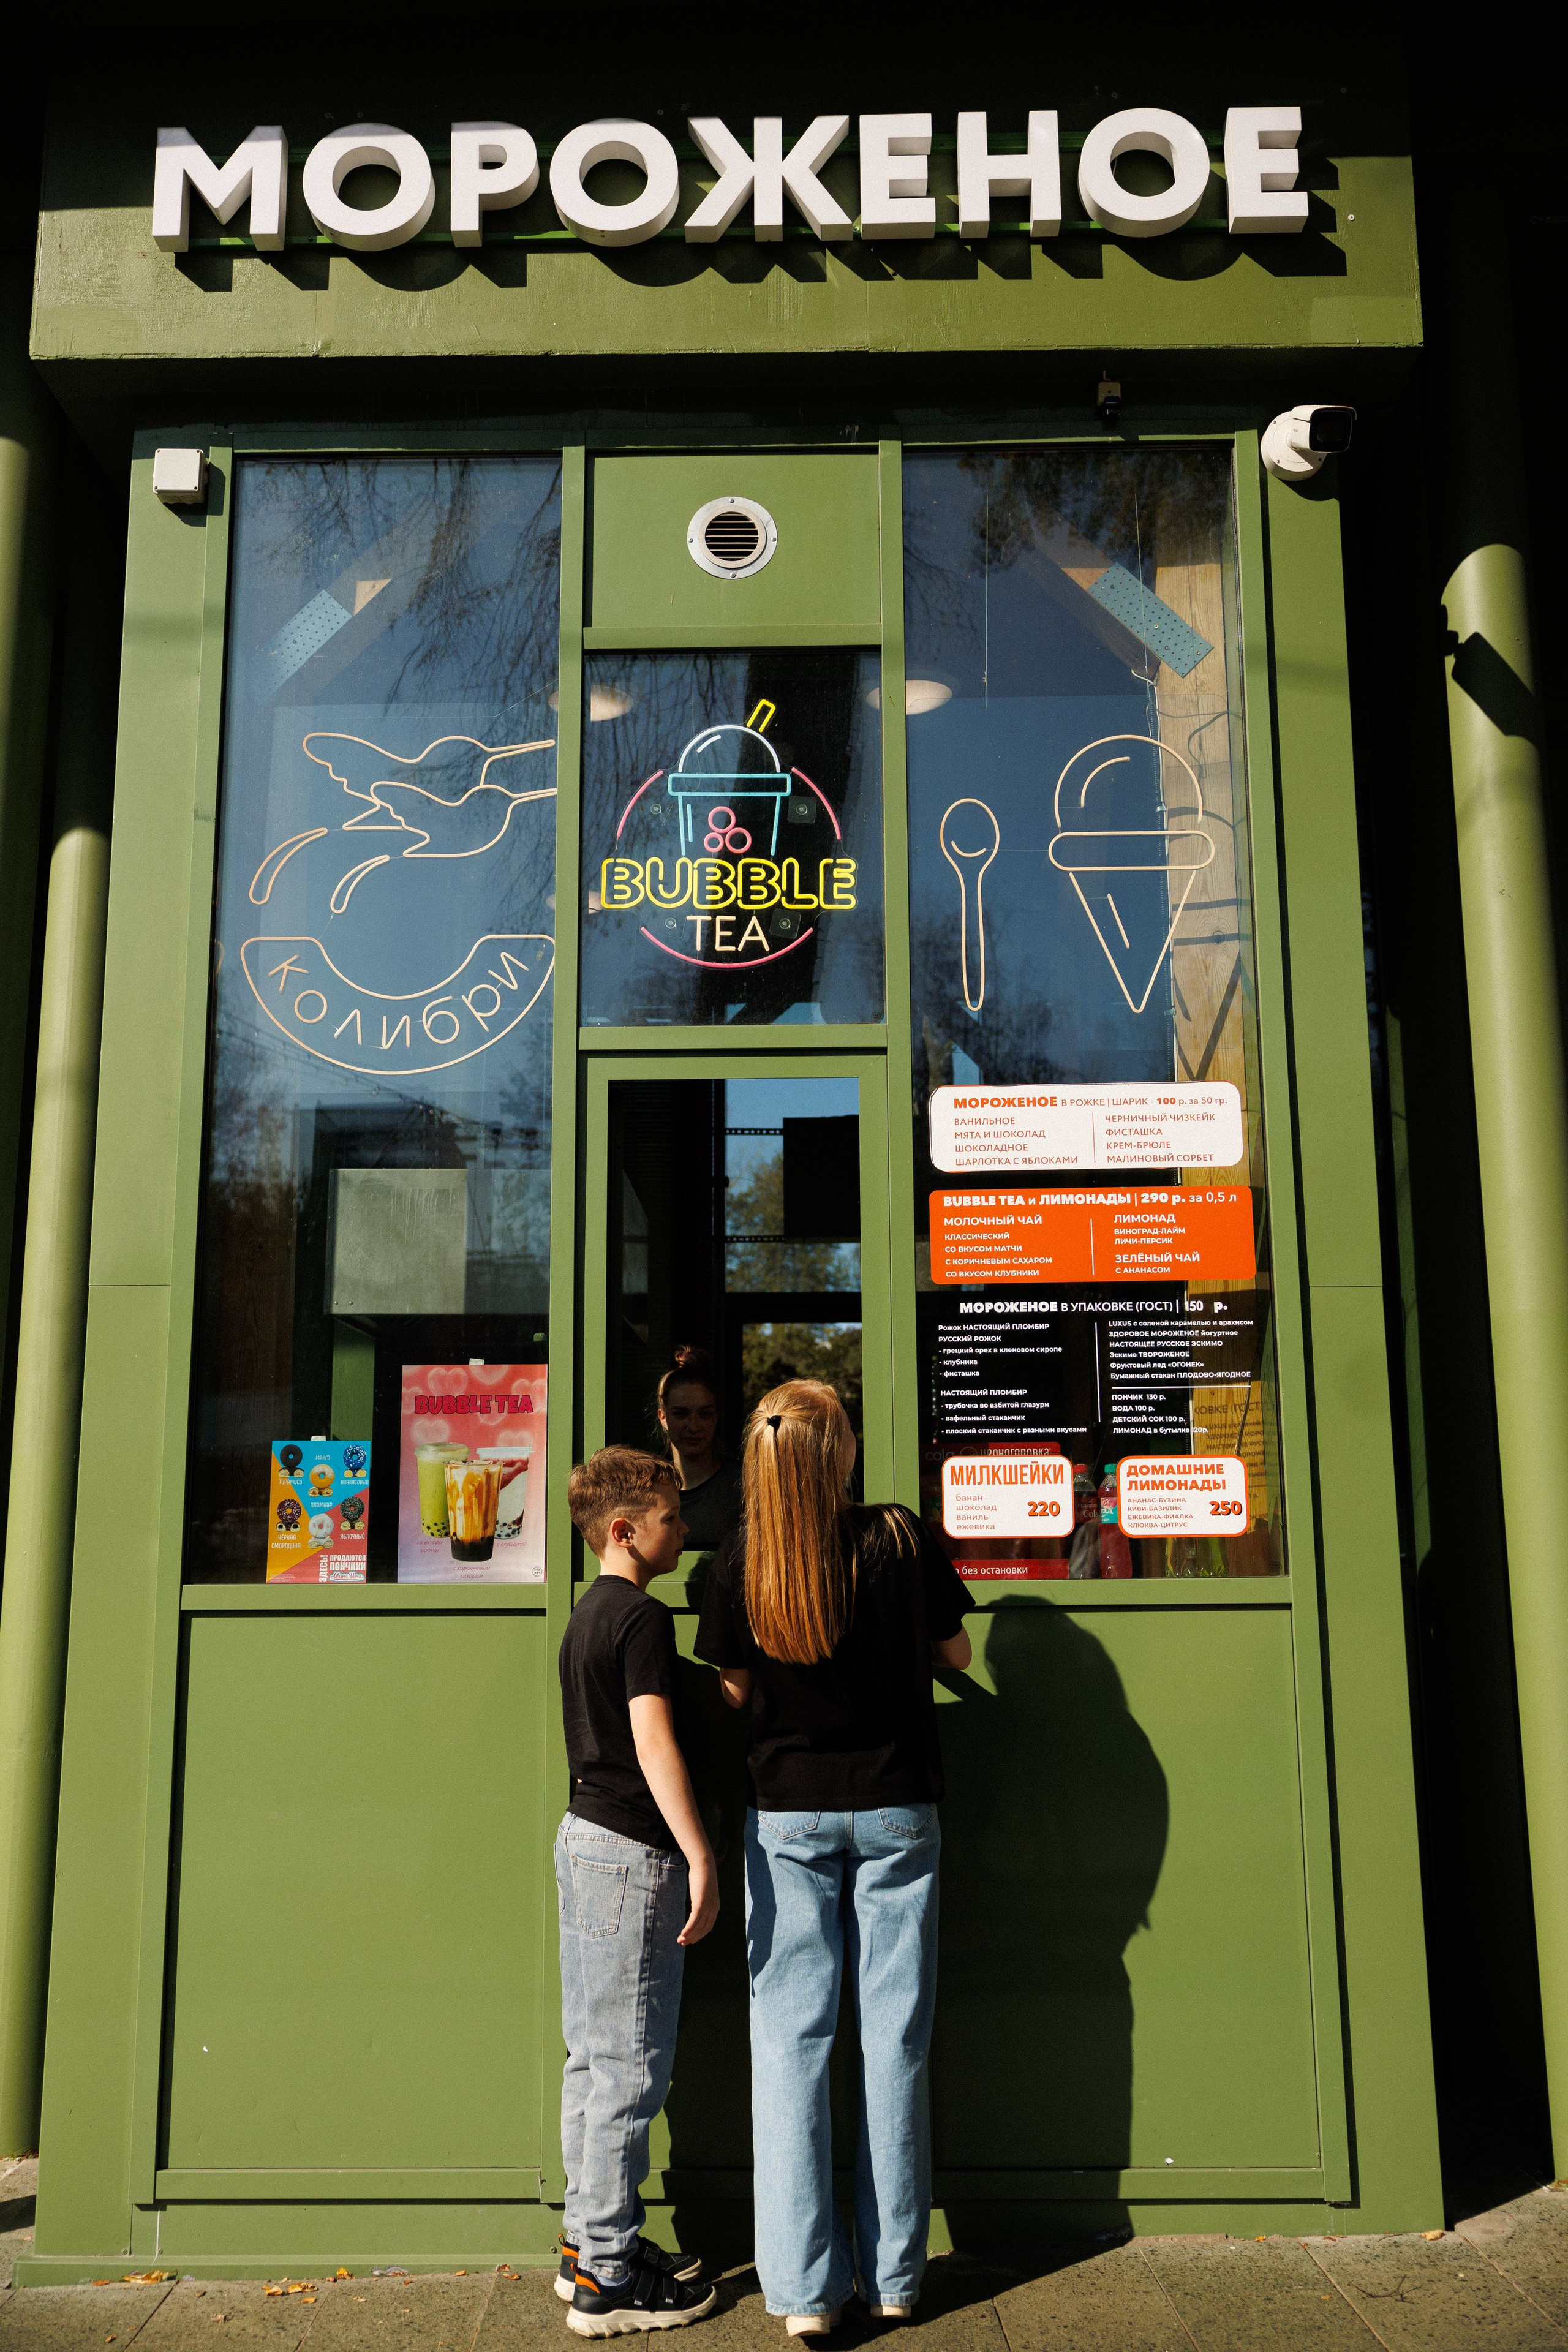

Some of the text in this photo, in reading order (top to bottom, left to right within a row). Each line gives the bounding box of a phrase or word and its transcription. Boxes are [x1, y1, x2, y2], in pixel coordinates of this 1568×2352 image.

[152, 107, 1308, 251] МОРОЖЕНОЕ
[601, 858, 856, 909] BUBBLE
[687, 916, 769, 951] TEA
[954, 1096, 1057, 1109] МОРОЖЕНОЕ
[954, 1117, 1014, 1126] ВАНИЛЬНОЕ
[1105, 1112, 1215, 1123] ЧЕРНИЧНЫЙ ЧИЗКЕЙК
[1106, 1128, 1163, 1136] ФИСТАШКА
[956, 1144, 1028, 1152] ШОКОЛАДНОЕ
[1107, 1153, 1174, 1163] МАЛИНОВЫЙ
[944, 1196, 996, 1206] BUBBLE
[998, 1195, 1025, 1205] TEA
[1039, 1194, 1131, 1205] ЛИМОНАДЫ
[1141, 1193, 1168, 1203] 290
[1172, 1195, 1185, 1205] р.
[1206, 1192, 1225, 1203] 0,5
[944, 1214, 1042, 1226] МОЛОЧНЫЙ ЧАЙ
[1114, 1214, 1175, 1223] ЛИМОНАД
[1115, 1251, 1200, 1262] ЗЕЛЁНЫЙ ЧАЙ
[960, 1300, 1227, 1313] МОРОЖЕНОЕ В УПАКОВКЕ (ГОСТ) 150 р.
[415, 1395, 533, 1414] BUBBLE TEA
[951, 1461, 1064, 1485] МИЛКШЕЙКИ
[1126, 1464, 1224, 1477] ДОМАШНИЕ
[1127, 1479, 1226, 1491] ЛИМОНАДЫ
[1027, 1501, 1060, 1516] 220
[1209, 1500, 1242, 1515] 250
[319, 1555, 328, 1582] ЗДЕСЬ!
[330, 1562, 366, 1570] ПОНЧИКИ
